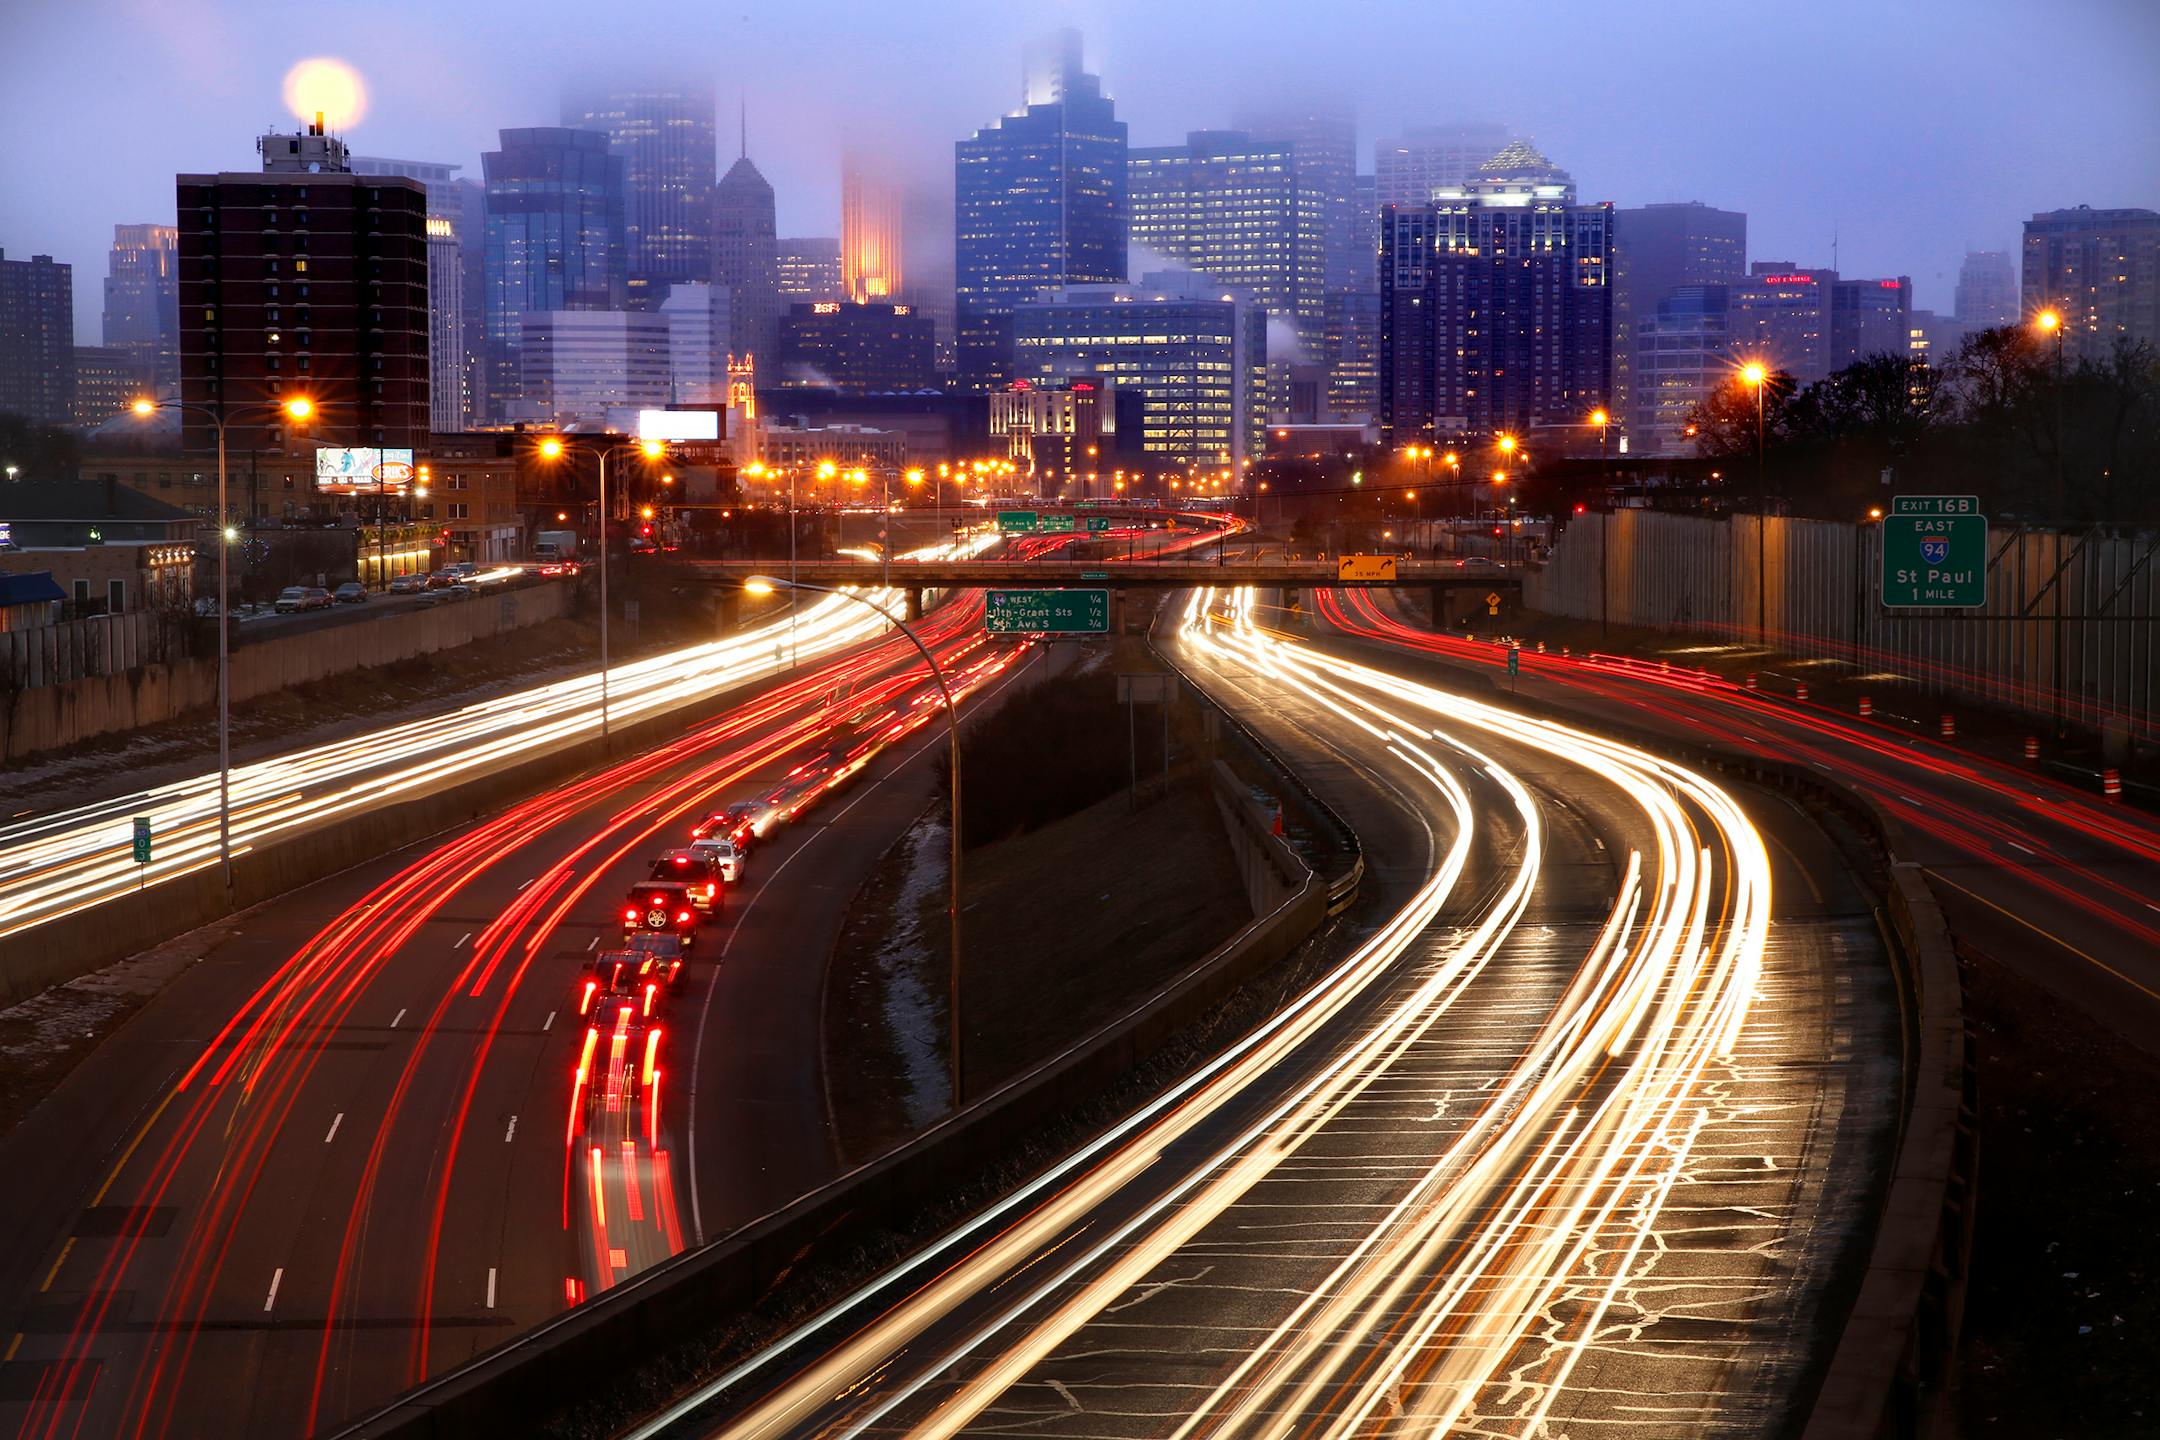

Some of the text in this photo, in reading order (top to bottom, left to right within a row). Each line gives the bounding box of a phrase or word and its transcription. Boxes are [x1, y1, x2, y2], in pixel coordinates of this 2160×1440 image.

[1901, 499, 1969, 513] EXIT 16B
[1915, 521, 1955, 532] EAST
[1924, 543, 1945, 557] 94
[1897, 569, 1972, 584] St Paul
[1009, 596, 1033, 604] WEST
[1912, 587, 1955, 601] 1 MILE
[1055, 607, 1073, 617] Sts
[1017, 620, 1037, 629] Ave
[1042, 619, 1050, 629] S
